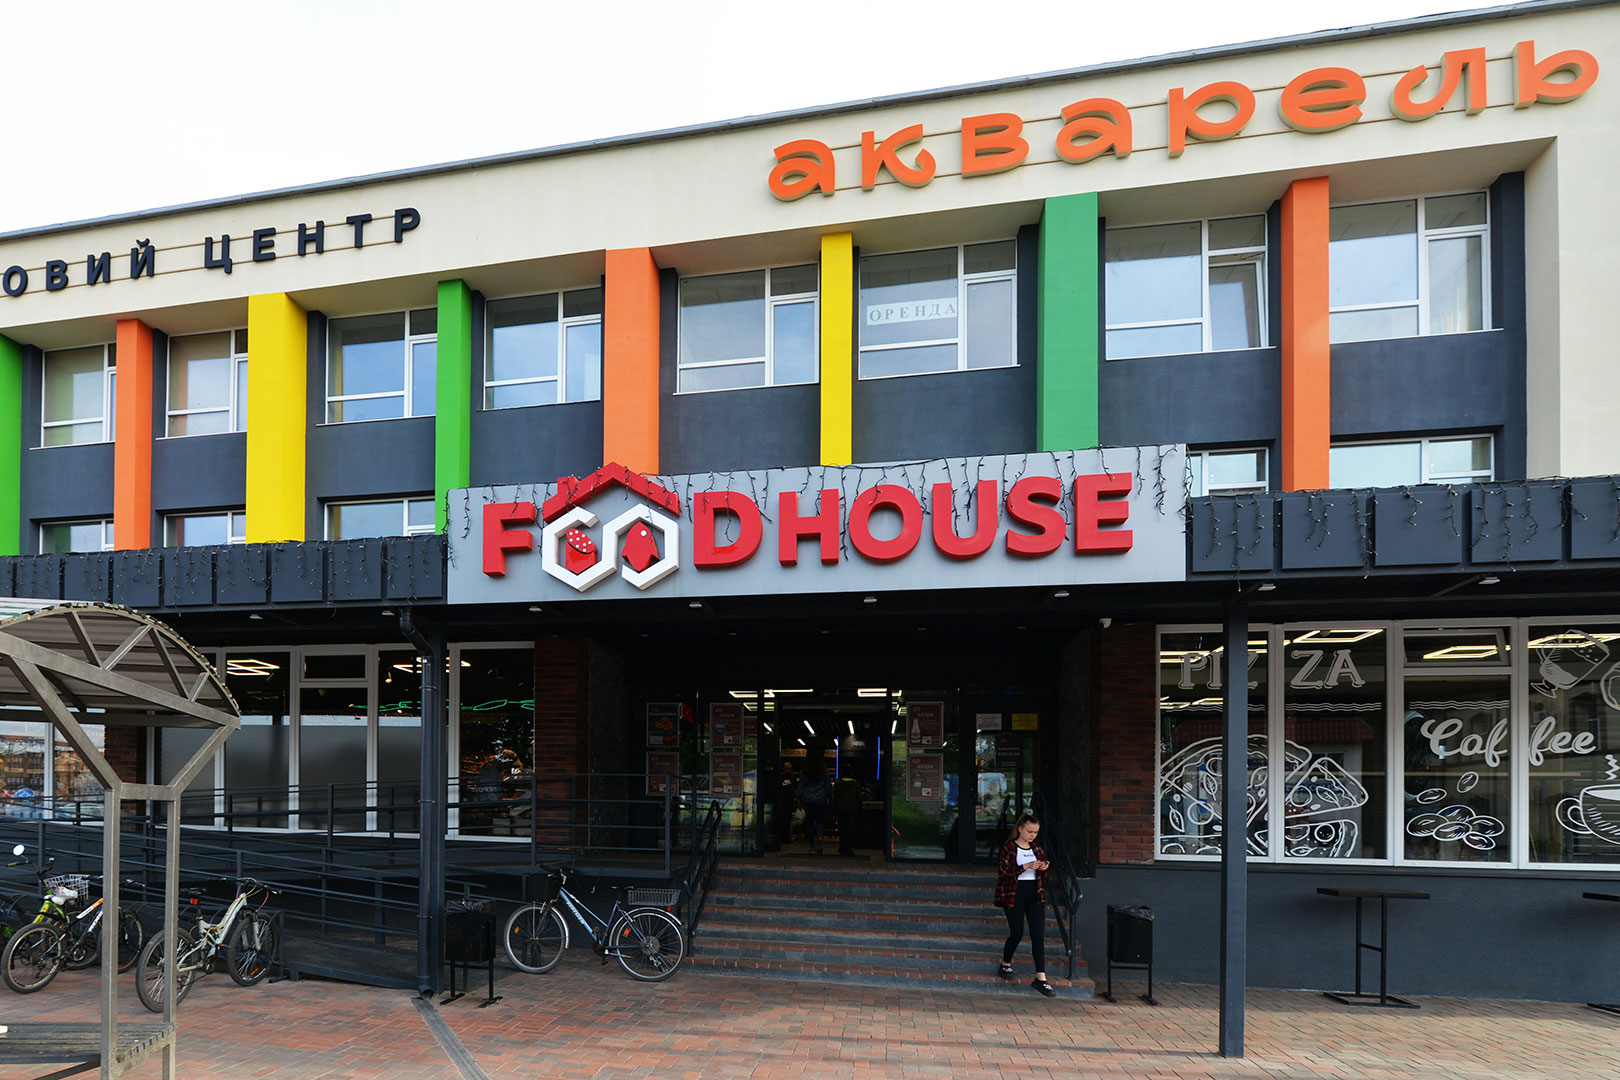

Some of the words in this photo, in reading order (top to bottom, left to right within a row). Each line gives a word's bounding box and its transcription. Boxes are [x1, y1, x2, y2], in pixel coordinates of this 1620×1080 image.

[204, 207, 421, 274] ЦЕНТР
[869, 303, 956, 322] ОРЕНДА
[1420, 716, 1596, 767] Coffee
